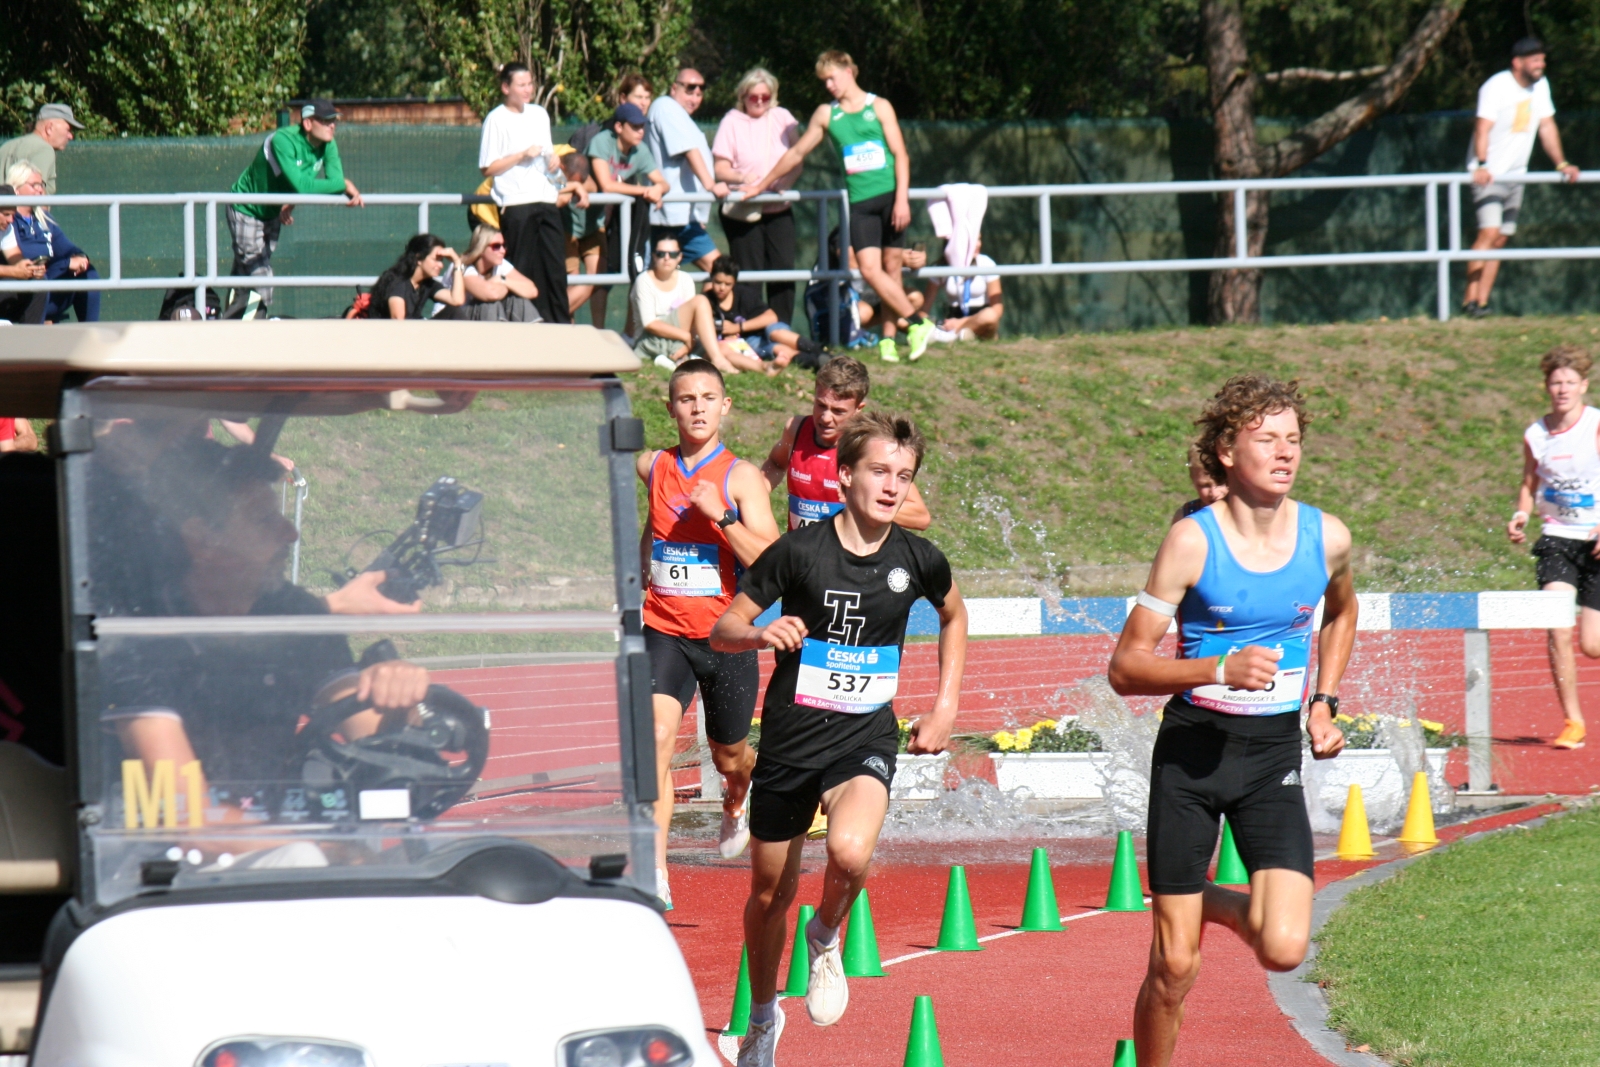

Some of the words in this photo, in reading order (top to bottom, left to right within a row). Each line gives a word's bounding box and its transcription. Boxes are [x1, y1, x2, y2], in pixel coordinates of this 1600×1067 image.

[798, 501, 820, 513] ČESKÁ
[663, 544, 688, 557] ČESKÁ
[669, 564, 689, 580] 61
[827, 647, 866, 664] ČESKÁ
[825, 661, 861, 671] spořitelna
[827, 672, 872, 693] 537
[802, 697, 817, 706] MČR
[816, 699, 841, 710] ŽACTVA
[832, 694, 862, 702] JEDLIČKA
[1215, 701, 1244, 713] ŽACTVA
[122, 759, 202, 829] M1
